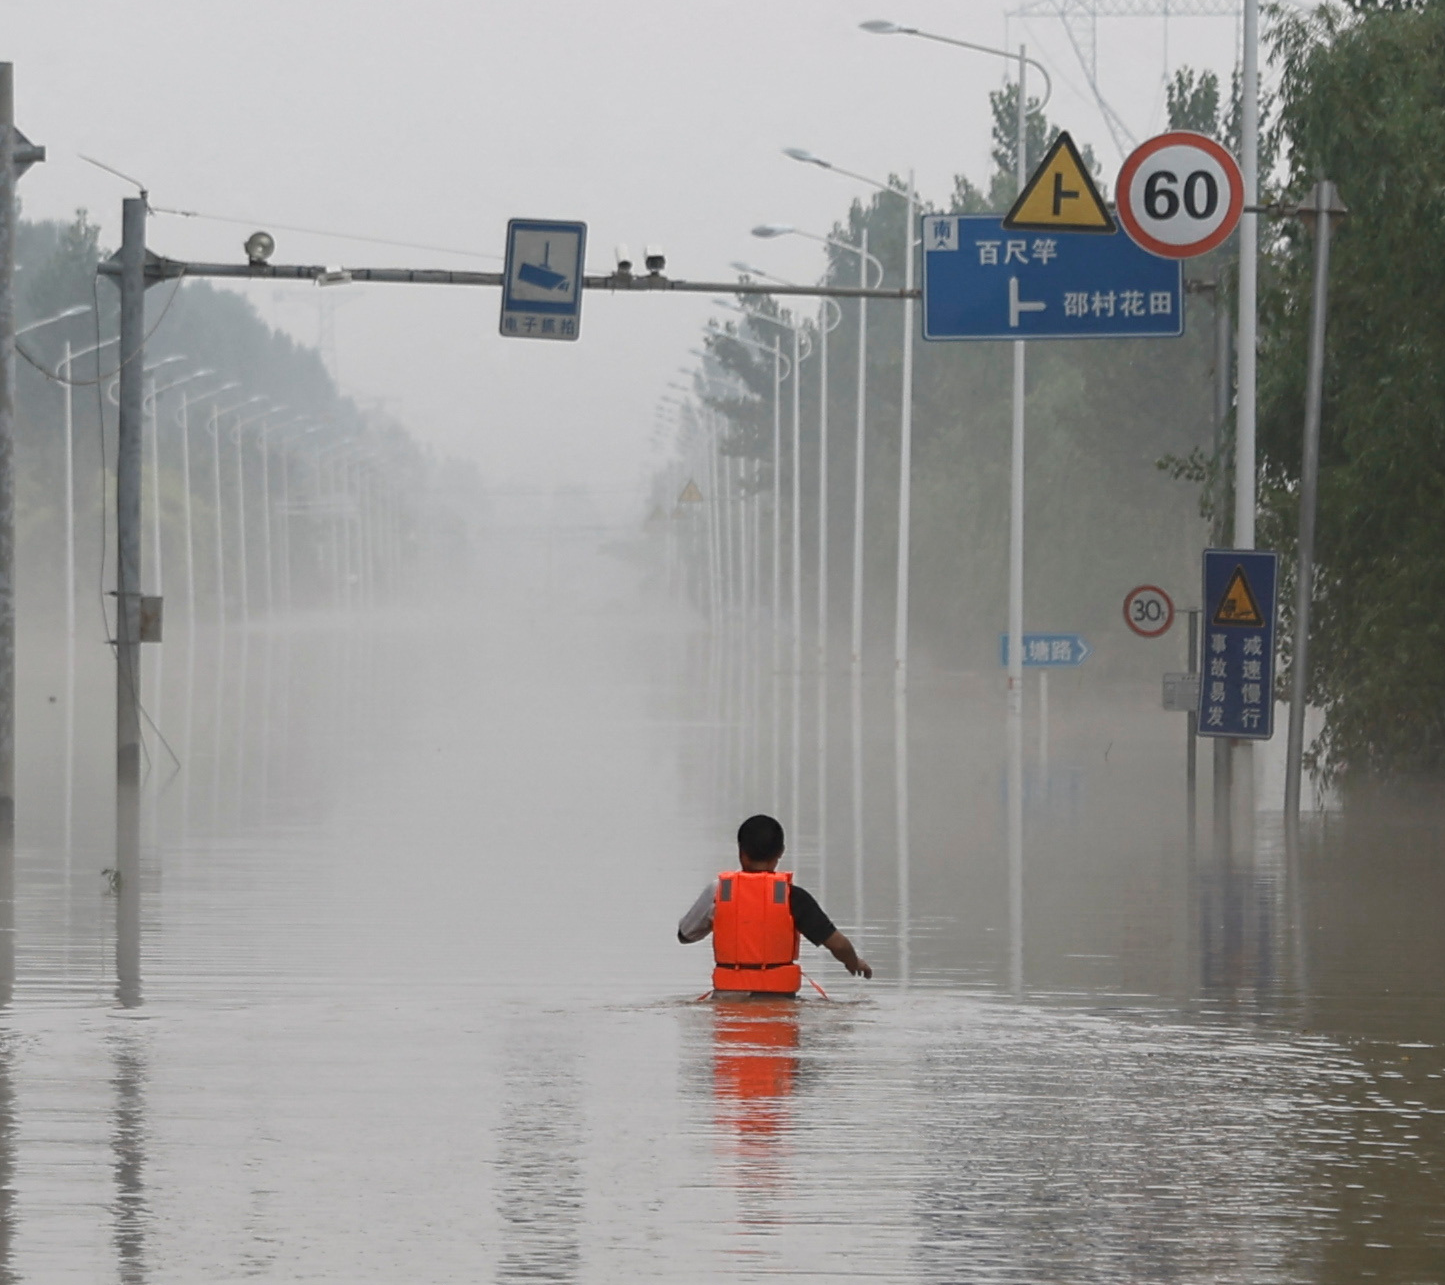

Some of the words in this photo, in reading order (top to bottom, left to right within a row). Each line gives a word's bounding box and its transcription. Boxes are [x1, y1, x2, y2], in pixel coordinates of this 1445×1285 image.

[1144, 170, 1218, 220] 60
[932, 220, 951, 241] 南
[975, 239, 1057, 265] 百尺竿
[1063, 290, 1172, 317] 邵村花田
[1133, 599, 1161, 622] 30
[1008, 640, 1072, 661] 塘路
[1207, 634, 1227, 727] 事故易发
[1241, 635, 1262, 729] 减速慢行
